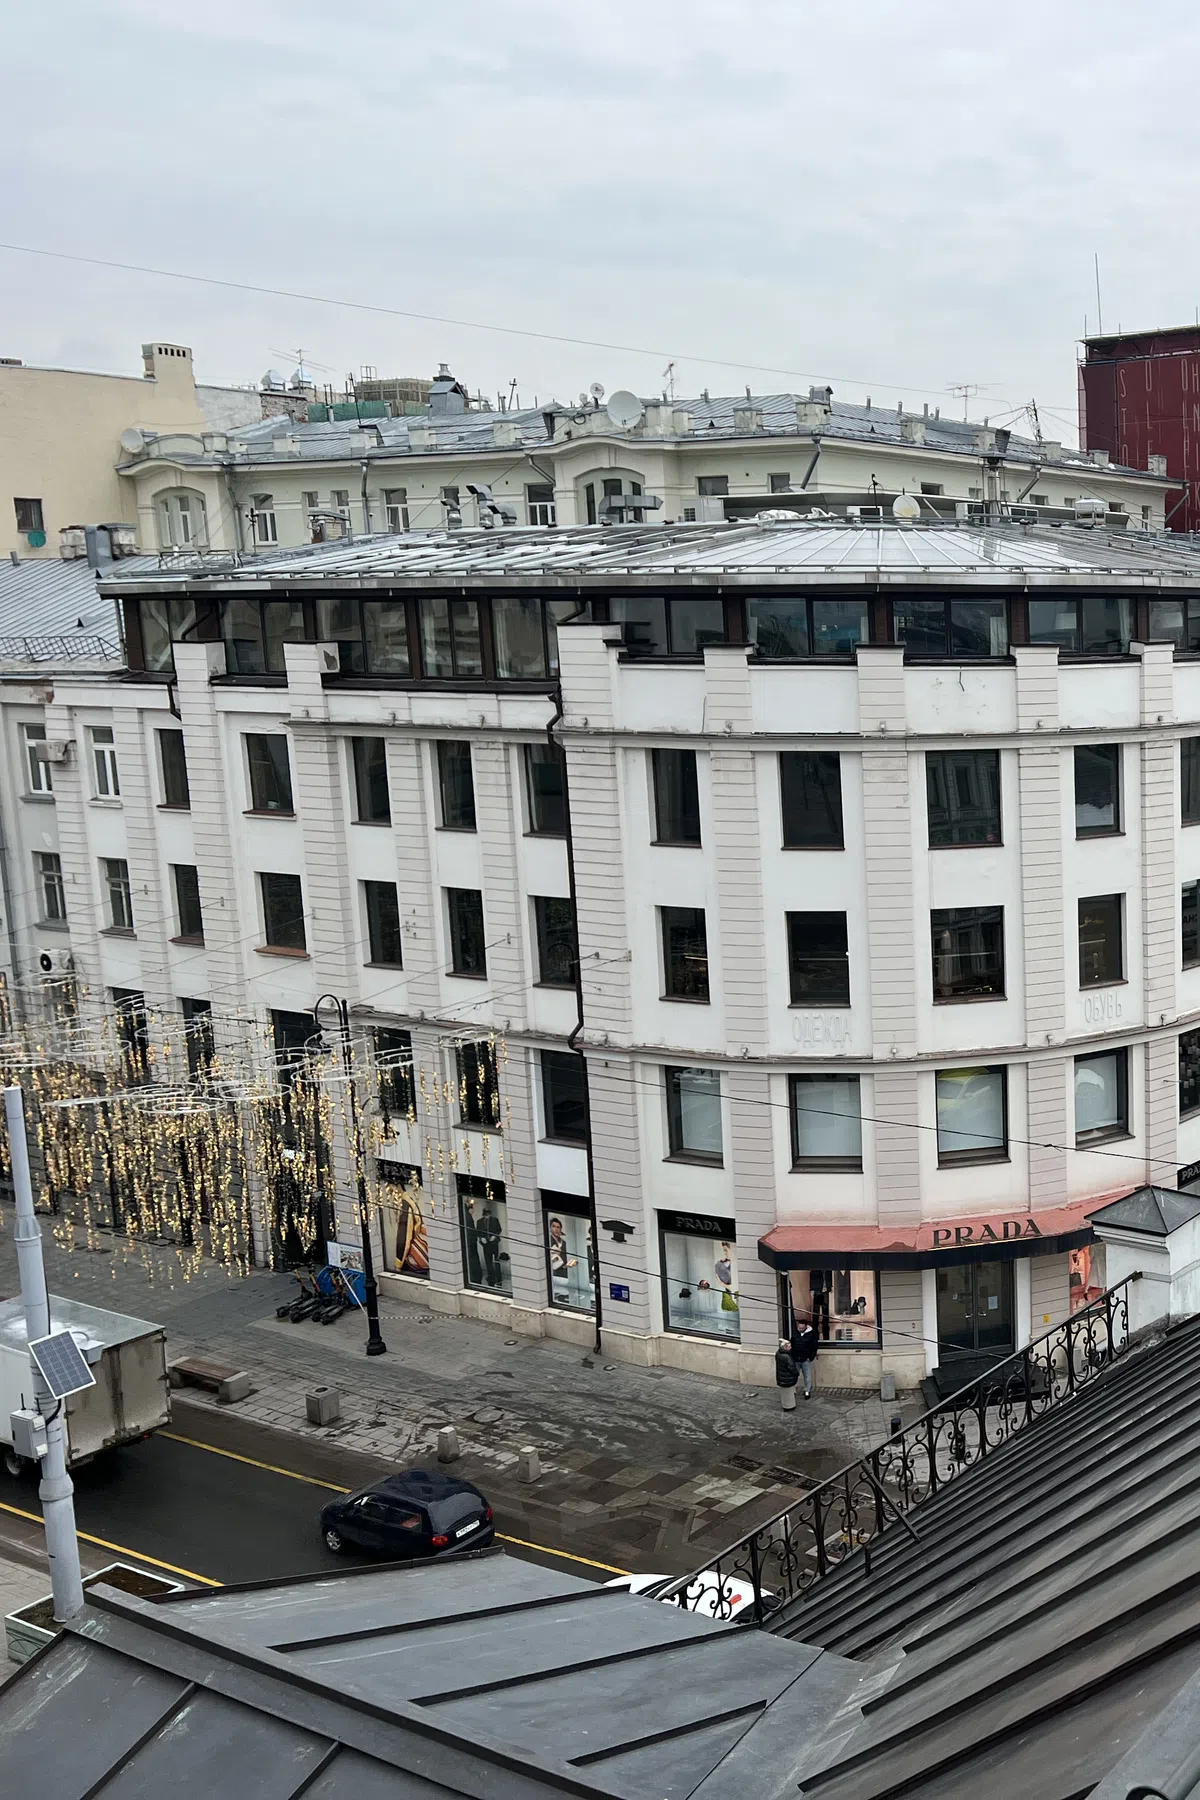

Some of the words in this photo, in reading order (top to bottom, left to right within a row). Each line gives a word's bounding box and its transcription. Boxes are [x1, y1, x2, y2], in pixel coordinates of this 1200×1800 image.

[1084, 992, 1123, 1024] ОБУВЬ
[792, 1013, 853, 1049] ОДЕЖДА
[675, 1216, 722, 1233] PRADA
[932, 1218, 1043, 1248] PRADA
